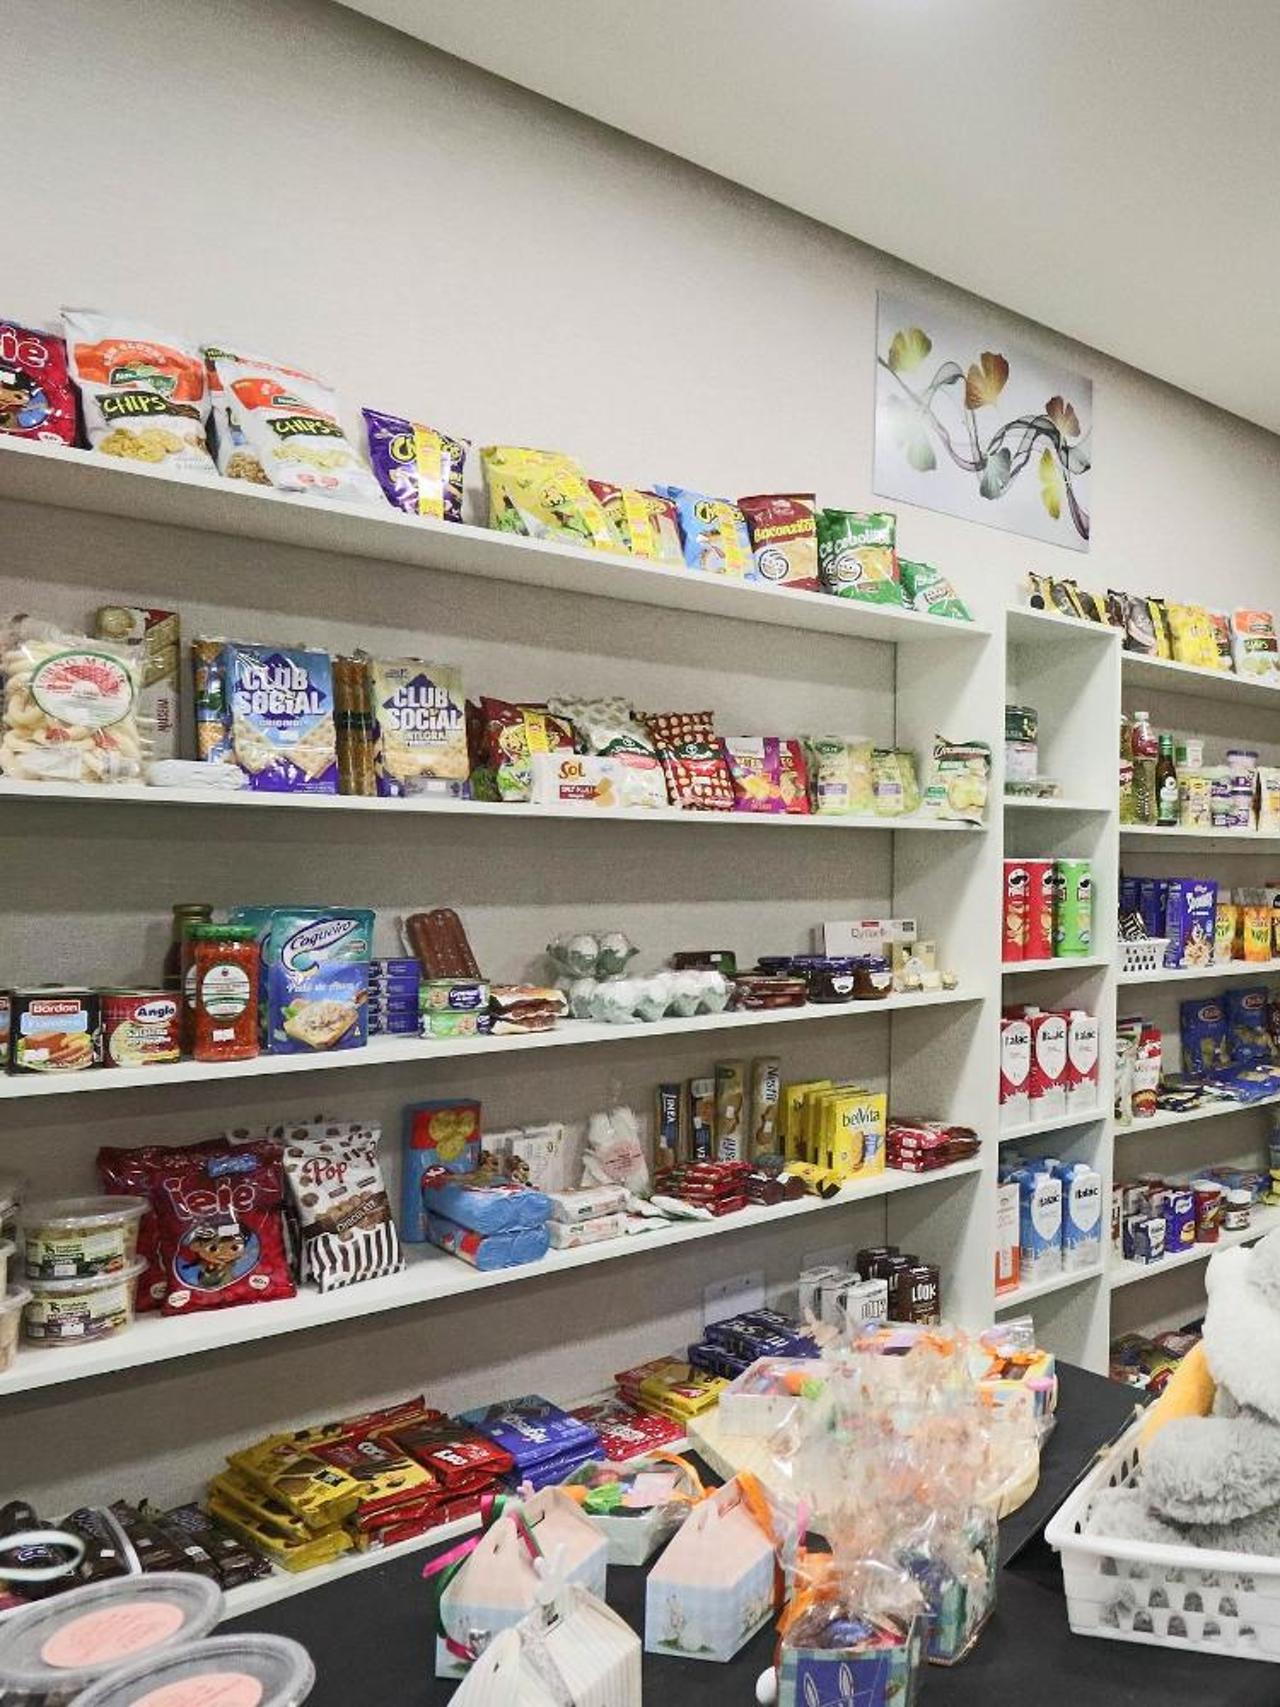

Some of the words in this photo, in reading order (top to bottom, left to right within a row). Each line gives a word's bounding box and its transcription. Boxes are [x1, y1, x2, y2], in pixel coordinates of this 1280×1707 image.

[103, 395, 167, 413] CHIPS
[275, 417, 330, 434] CHIPS
[241, 666, 309, 691] CLUB
[391, 687, 451, 708] CLUB
[290, 919, 353, 950] Coqueiro
[137, 1001, 175, 1019] Anglo
[842, 1105, 881, 1128] belVita
[304, 1156, 348, 1187] Pop
[911, 1281, 938, 1304] LOOK
